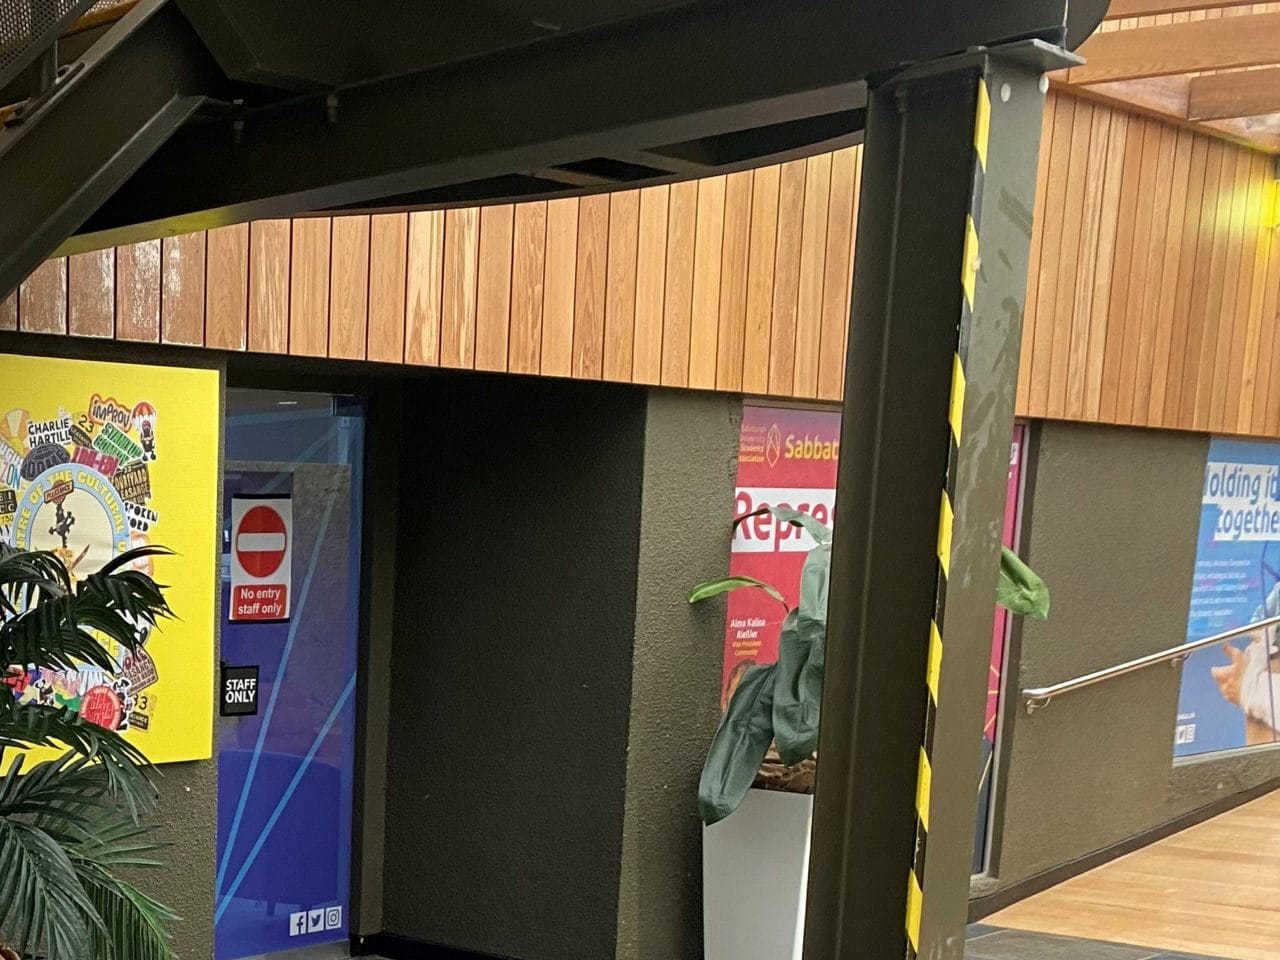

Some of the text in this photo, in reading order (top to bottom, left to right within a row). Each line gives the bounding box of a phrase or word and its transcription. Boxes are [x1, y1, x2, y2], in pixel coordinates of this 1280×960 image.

[28, 418, 70, 435] CHARLIE
[78, 471, 125, 534] CULTURAL
[241, 588, 281, 600] No entry
[238, 603, 282, 616] staff only
[225, 678, 256, 692] STAFF
[225, 690, 255, 703] ONLY
